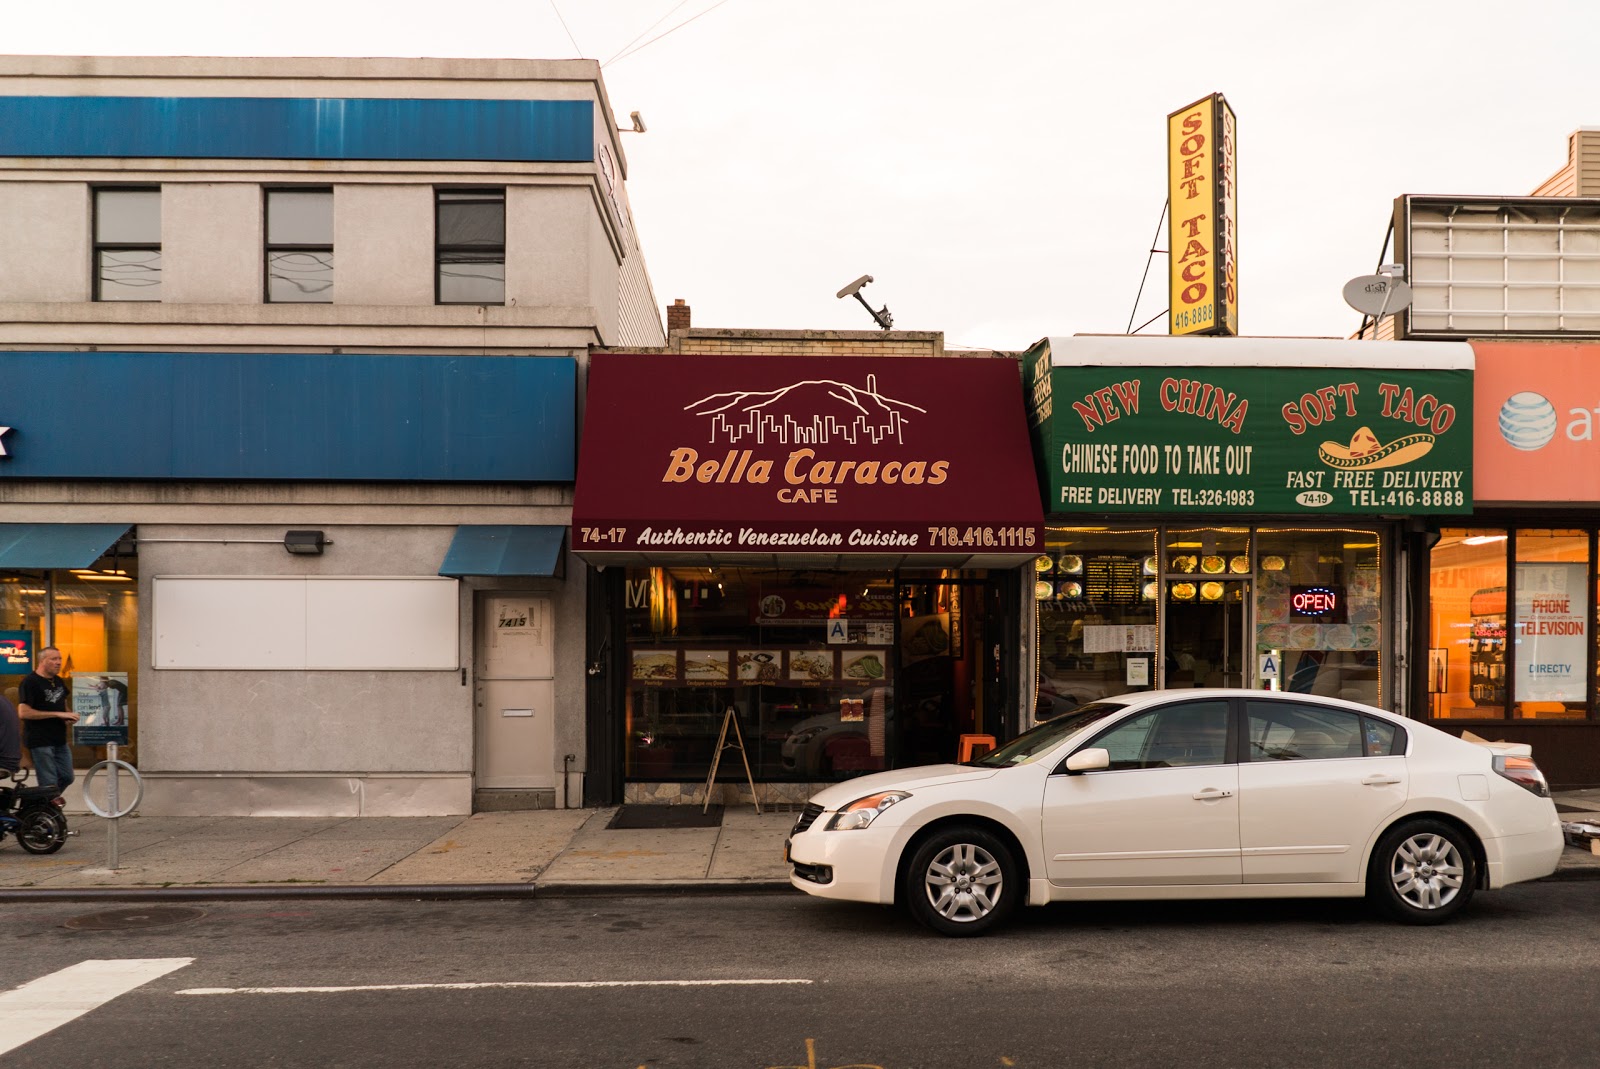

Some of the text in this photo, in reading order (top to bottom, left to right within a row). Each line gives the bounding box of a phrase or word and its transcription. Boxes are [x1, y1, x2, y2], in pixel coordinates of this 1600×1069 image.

[1180, 112, 1205, 200] SOFT
[1178, 213, 1209, 304] TACO
[1072, 379, 1141, 432] NEW
[1159, 377, 1249, 434] CHINA
[1281, 382, 1456, 435] SOFT TACO
[661, 447, 950, 485] Bella Caracas
[1062, 443, 1253, 476] CHINESE FOOD TO TAKE OUT
[1286, 471, 1463, 488] FAST FREE DELIVERY
[776, 488, 838, 503] CAFE
[1061, 486, 1093, 503] FREE
[1098, 487, 1162, 505] DELIVERY
[1303, 493, 1328, 504] 74-19
[581, 527, 1036, 547] 74-17 Authentic Venezuelan Cuisine 718.416.1115
[1293, 594, 1336, 610] OPEN
[1532, 600, 1570, 613] PHONE
[498, 617, 527, 628] 7415
[831, 622, 844, 637] A
[1520, 621, 1584, 636] TELEVISION
[1262, 657, 1276, 673] A
[1529, 664, 1572, 673] DIRECTV
